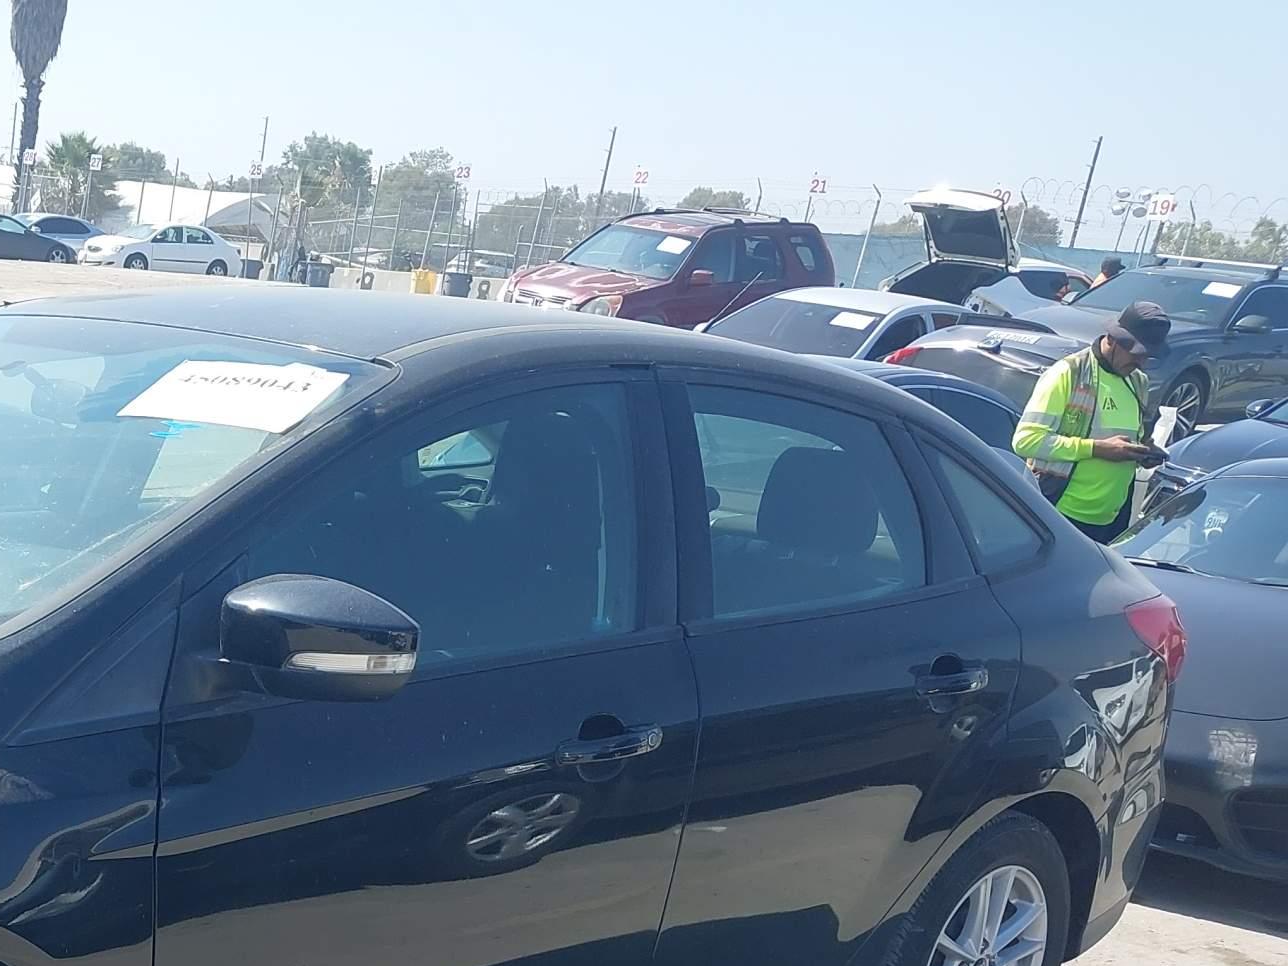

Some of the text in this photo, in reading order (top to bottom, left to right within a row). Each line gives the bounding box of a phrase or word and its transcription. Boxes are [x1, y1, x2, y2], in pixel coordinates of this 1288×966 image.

[91, 157, 102, 168] 27
[250, 164, 262, 176] 25
[456, 166, 470, 178] 23
[635, 171, 648, 183] 22
[809, 179, 827, 193] 21
[1149, 199, 1171, 215] 19
